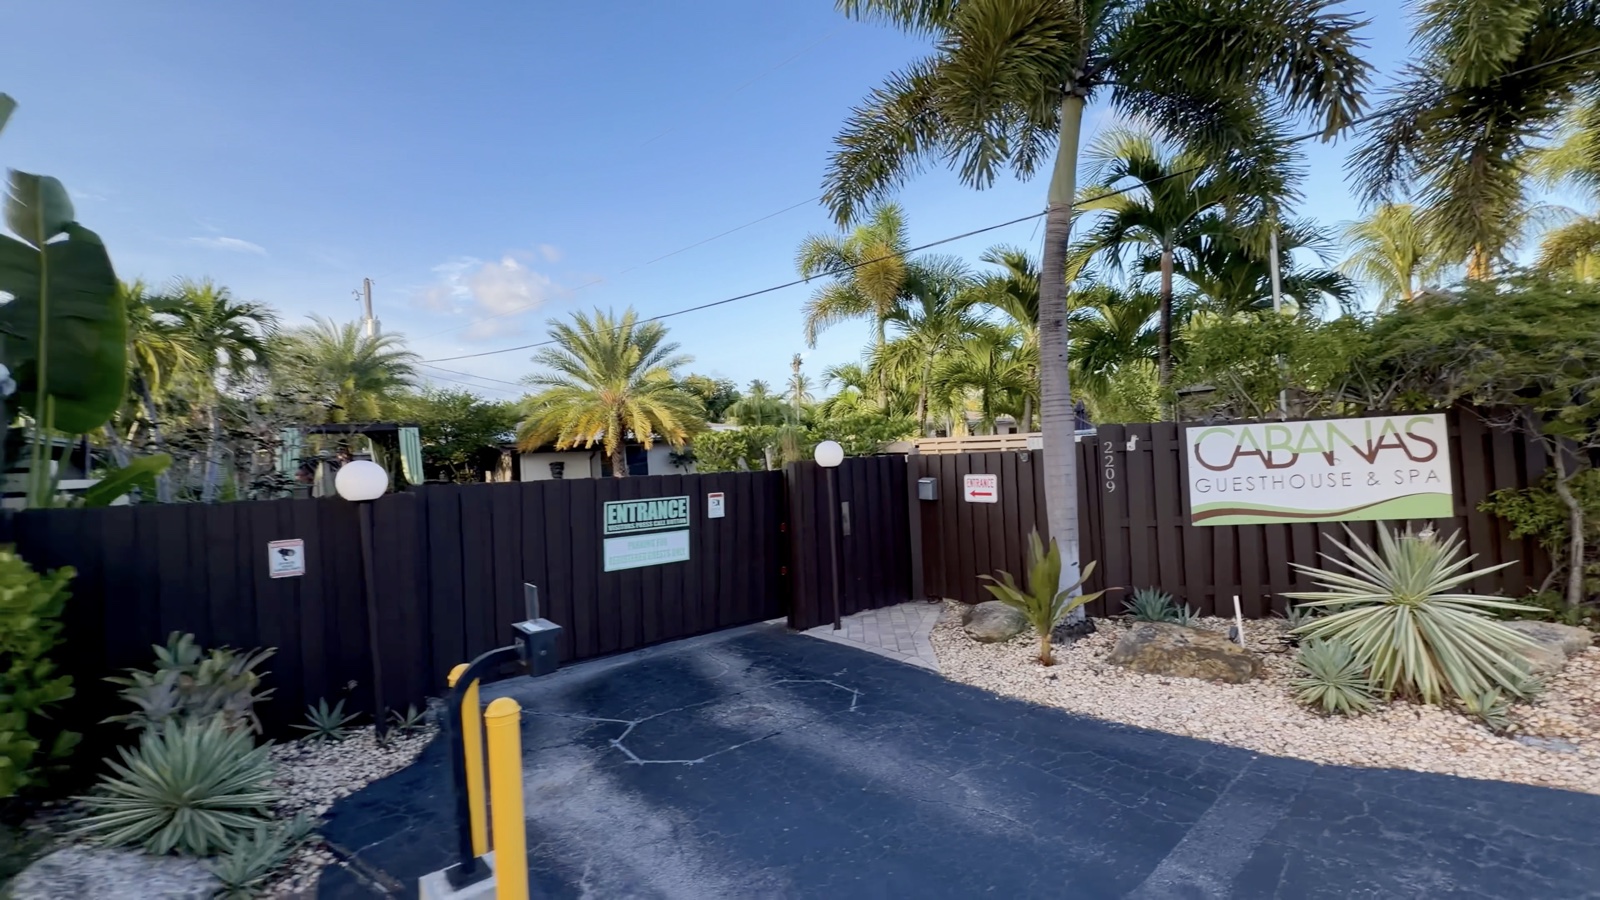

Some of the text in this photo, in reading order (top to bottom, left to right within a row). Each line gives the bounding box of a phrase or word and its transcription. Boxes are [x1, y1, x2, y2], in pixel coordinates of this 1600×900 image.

[1194, 416, 1438, 471] CABANAS
[1103, 441, 1116, 493] 2209
[966, 478, 994, 489] ENTRANCE
[1195, 469, 1440, 493] GUESTHOUSE & SPA
[607, 499, 686, 525] ENTRANCE
